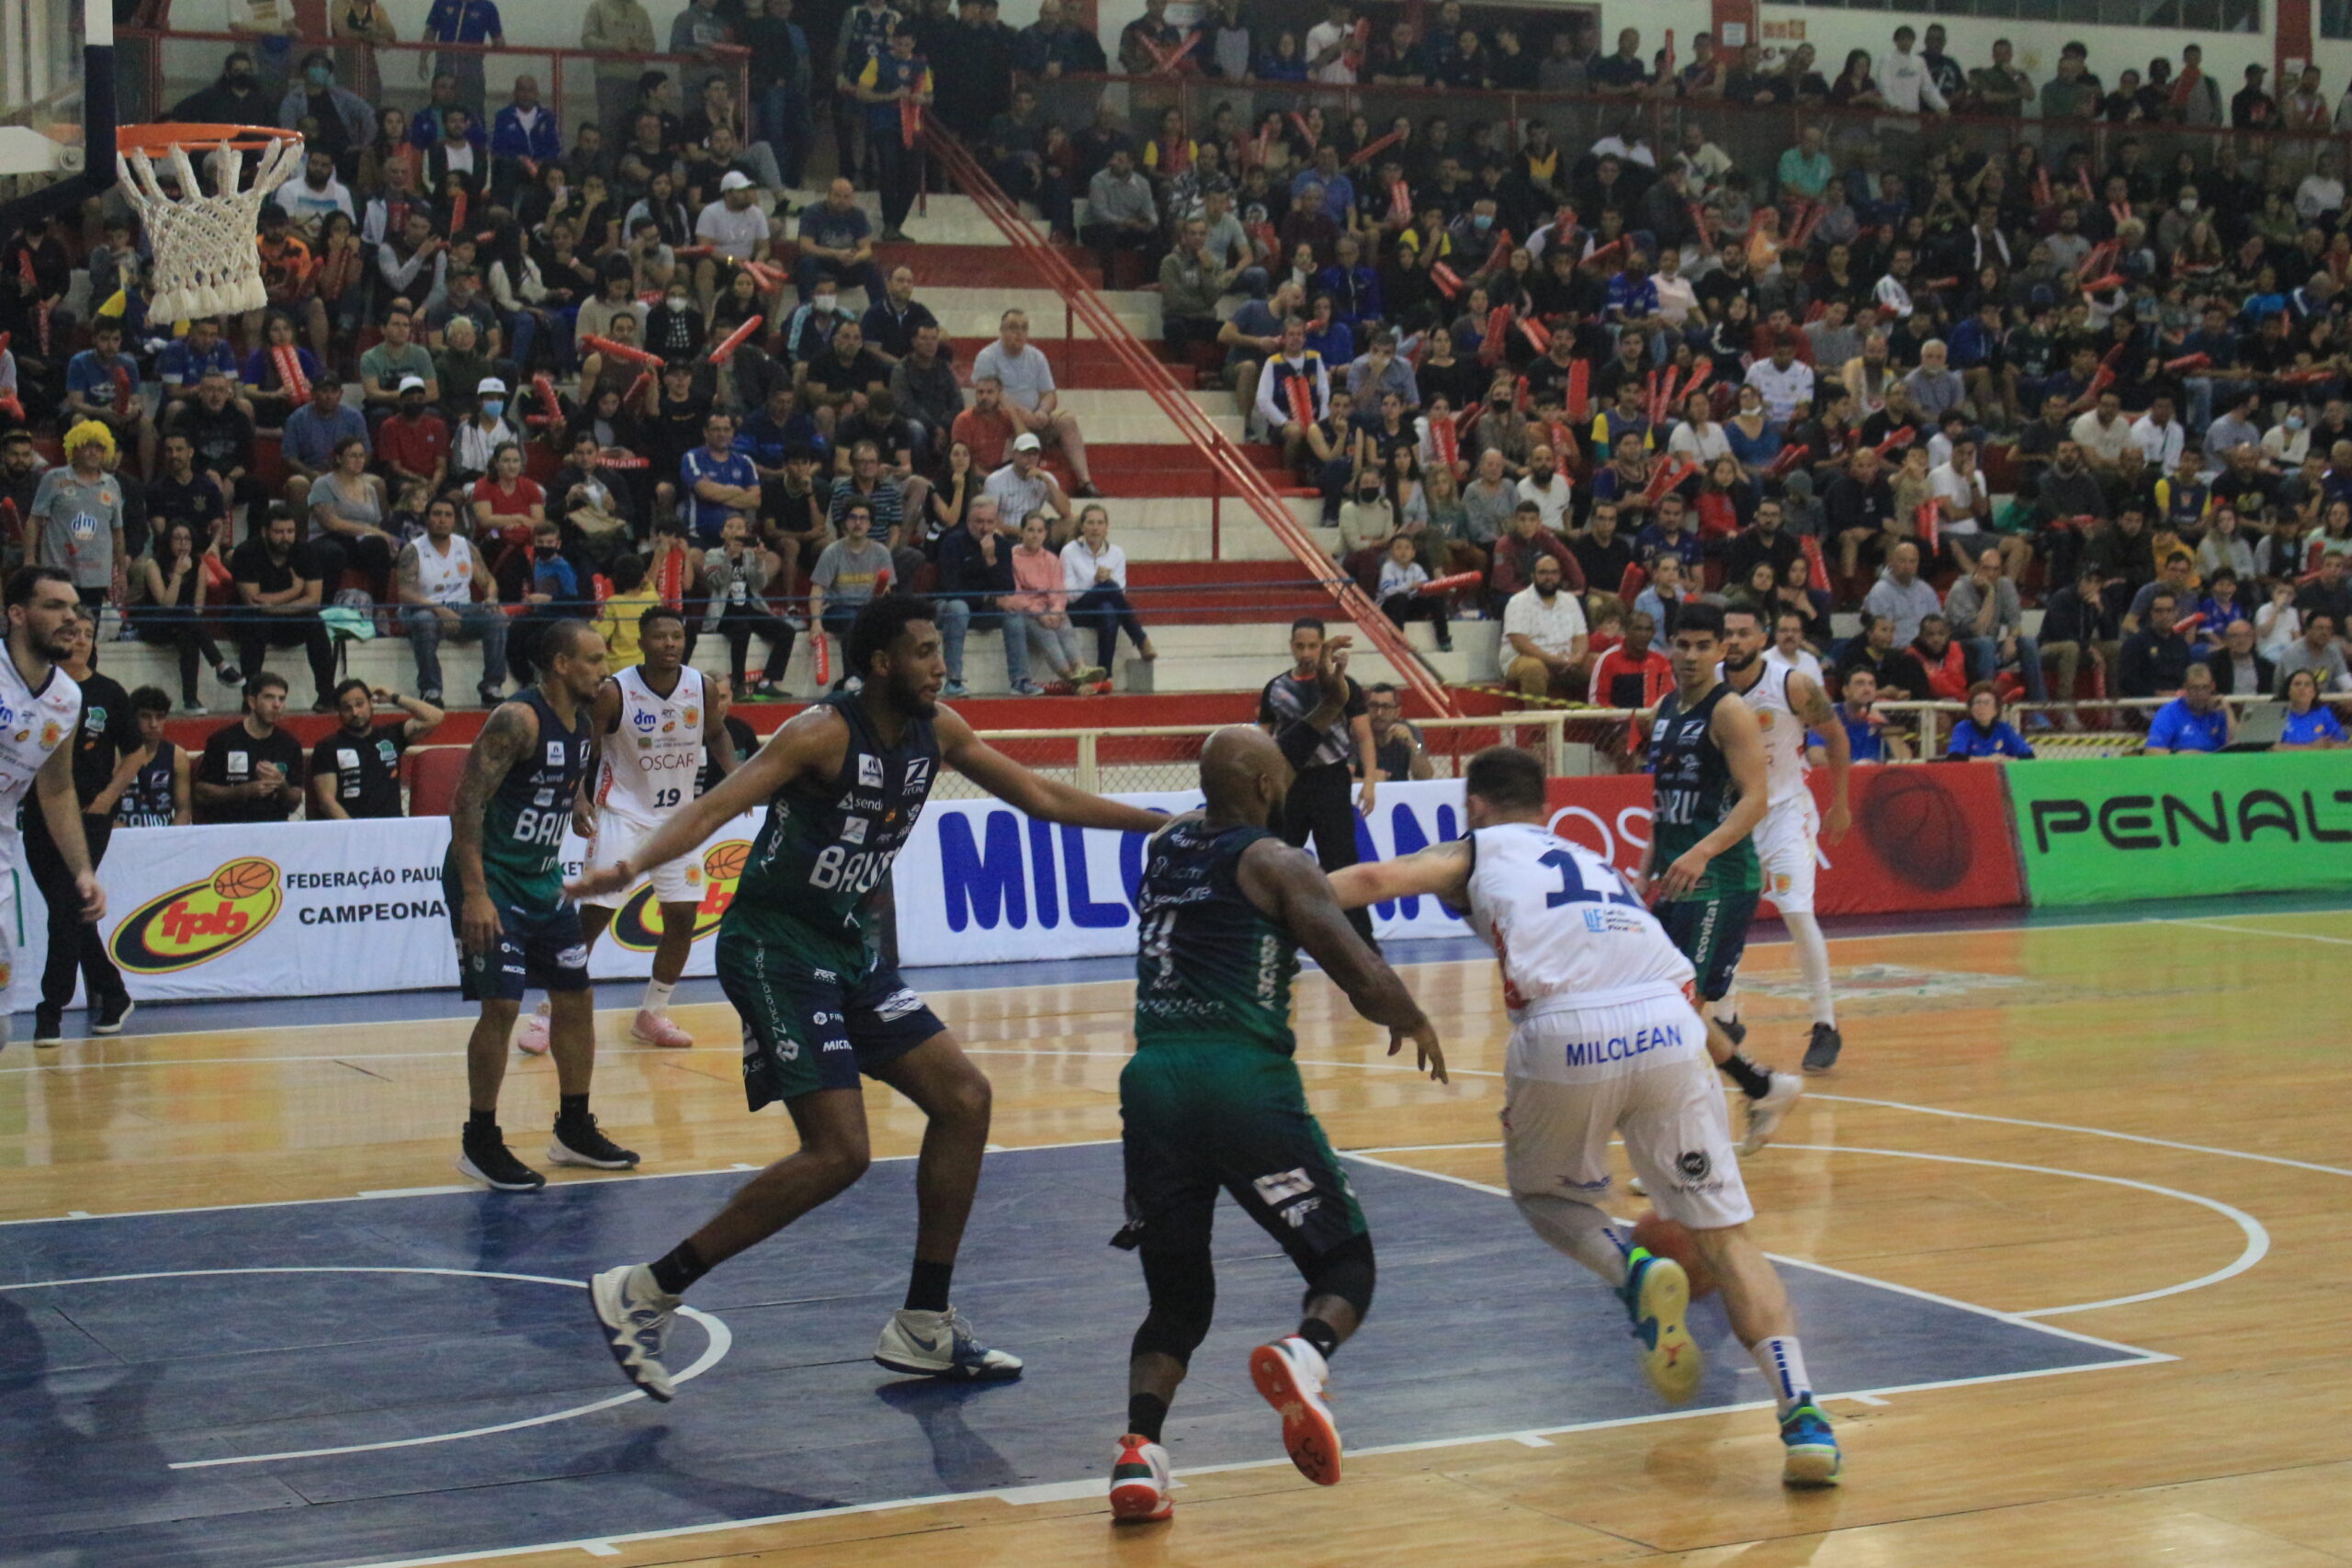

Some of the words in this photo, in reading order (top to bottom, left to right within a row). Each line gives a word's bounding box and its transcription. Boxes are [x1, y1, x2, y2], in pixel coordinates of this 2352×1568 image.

[653, 788, 682, 809] 19
[287, 867, 396, 890] FEDERAÇÃO
[162, 901, 249, 944] fpb
[1567, 1024, 1683, 1067] MILCLEAN
